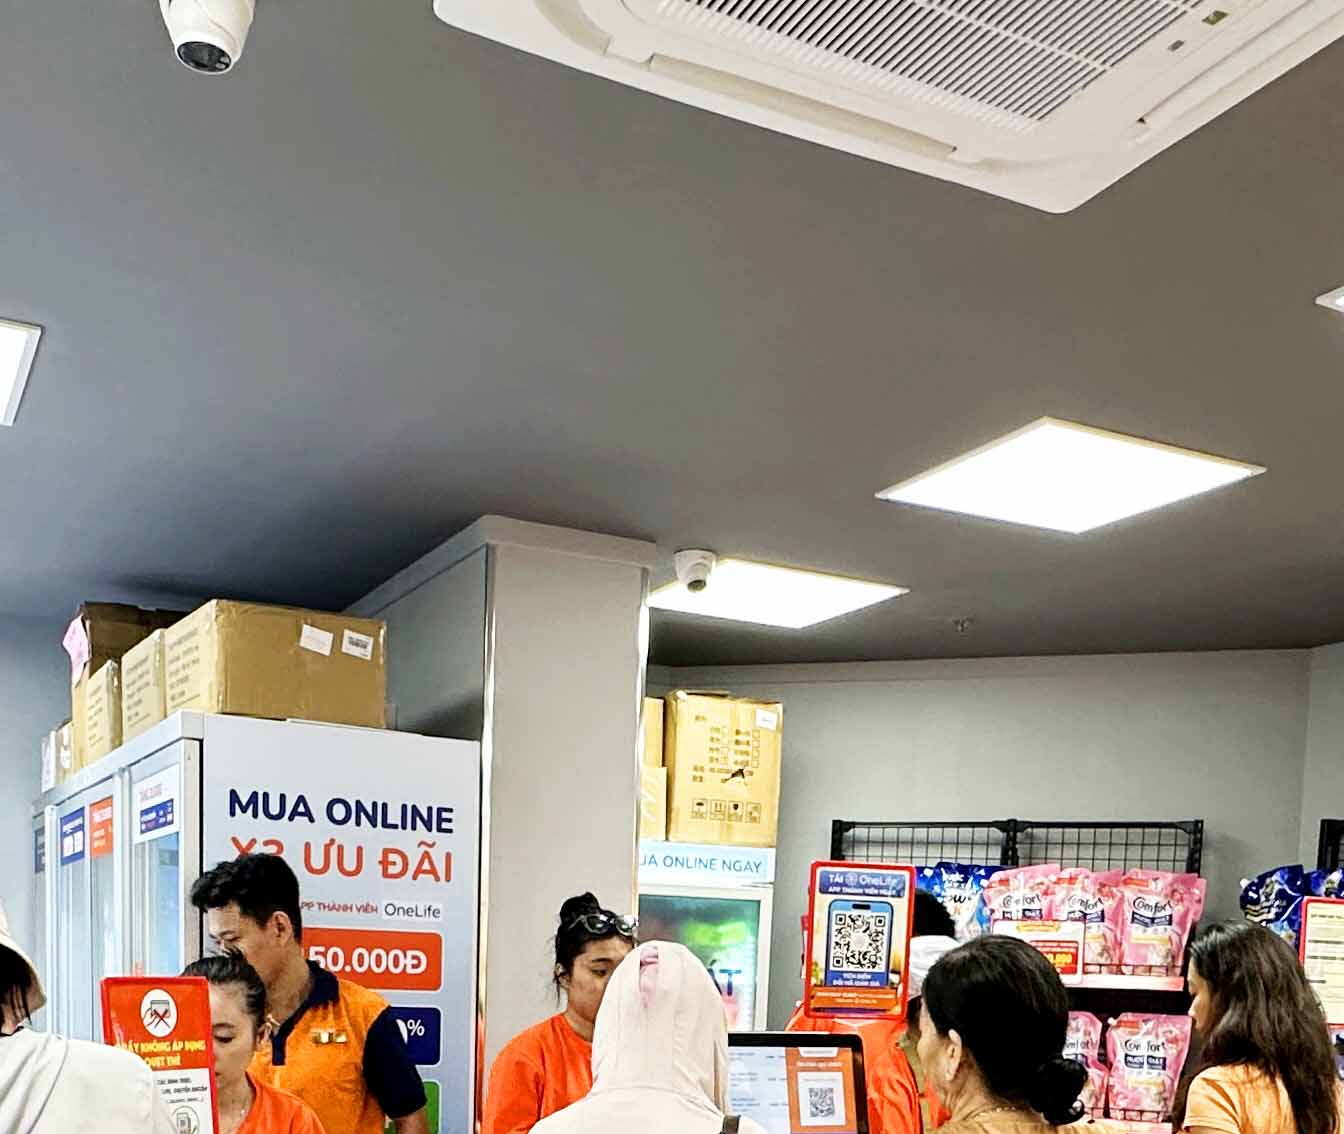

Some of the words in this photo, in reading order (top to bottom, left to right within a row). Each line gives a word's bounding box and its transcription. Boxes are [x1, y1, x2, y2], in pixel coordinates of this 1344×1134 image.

[229, 788, 315, 823] MUA
[326, 798, 454, 834] ONLINE
[304, 838, 363, 877] ƯU
[378, 840, 452, 882] ĐÃI
[663, 855, 717, 870] ONLINE
[721, 859, 763, 873] NGAY
[384, 903, 441, 918] OneLife
[1132, 895, 1172, 913] Comfort
